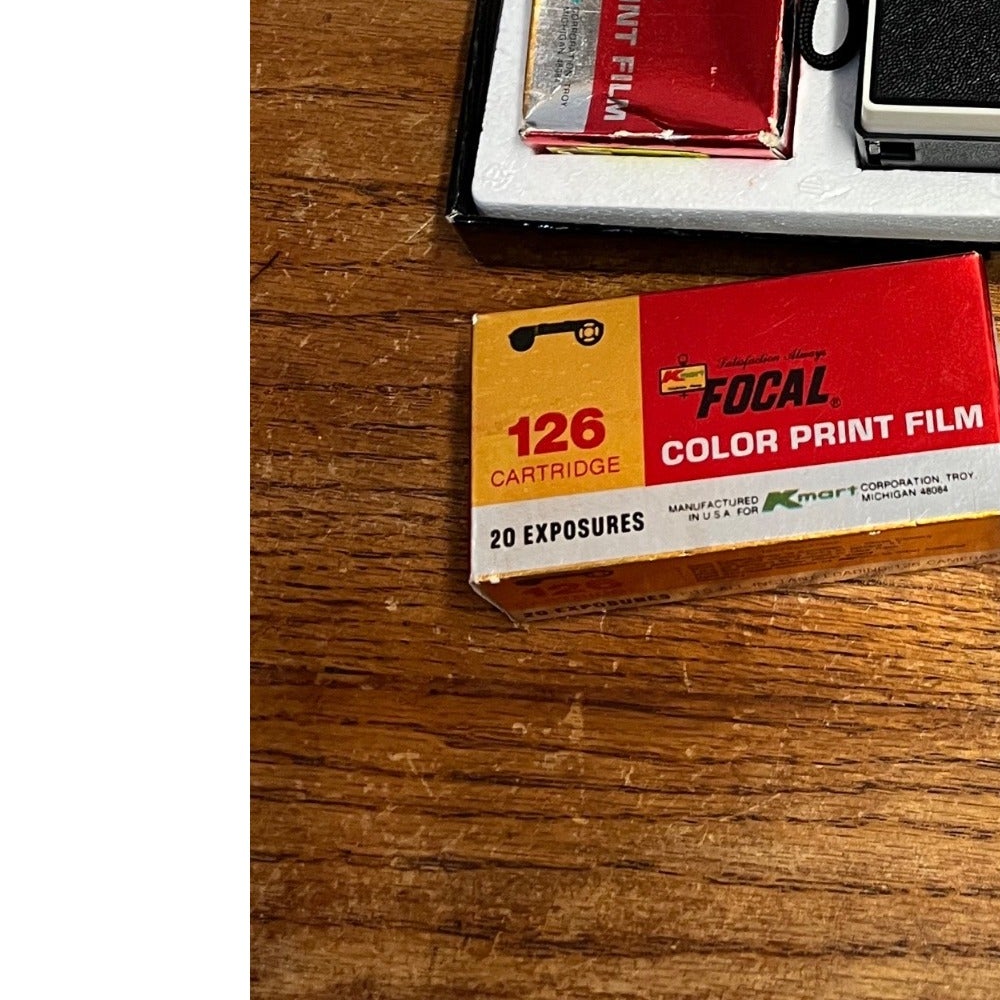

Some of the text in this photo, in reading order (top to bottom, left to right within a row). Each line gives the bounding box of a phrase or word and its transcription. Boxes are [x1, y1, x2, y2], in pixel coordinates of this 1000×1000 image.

[603, 56, 635, 121] FILM
[696, 366, 829, 419] FOCAL
[507, 407, 606, 458] 126
[661, 404, 983, 467] COLOR PRINT FILM
[490, 455, 620, 488] CARTRIDGE
[668, 496, 759, 513] MANUFACTURED
[862, 485, 949, 502] MICHIGAN 48084
[490, 510, 645, 550] 20 EXPOSURES
[688, 512, 700, 522] IN
[737, 506, 759, 517] FOR
